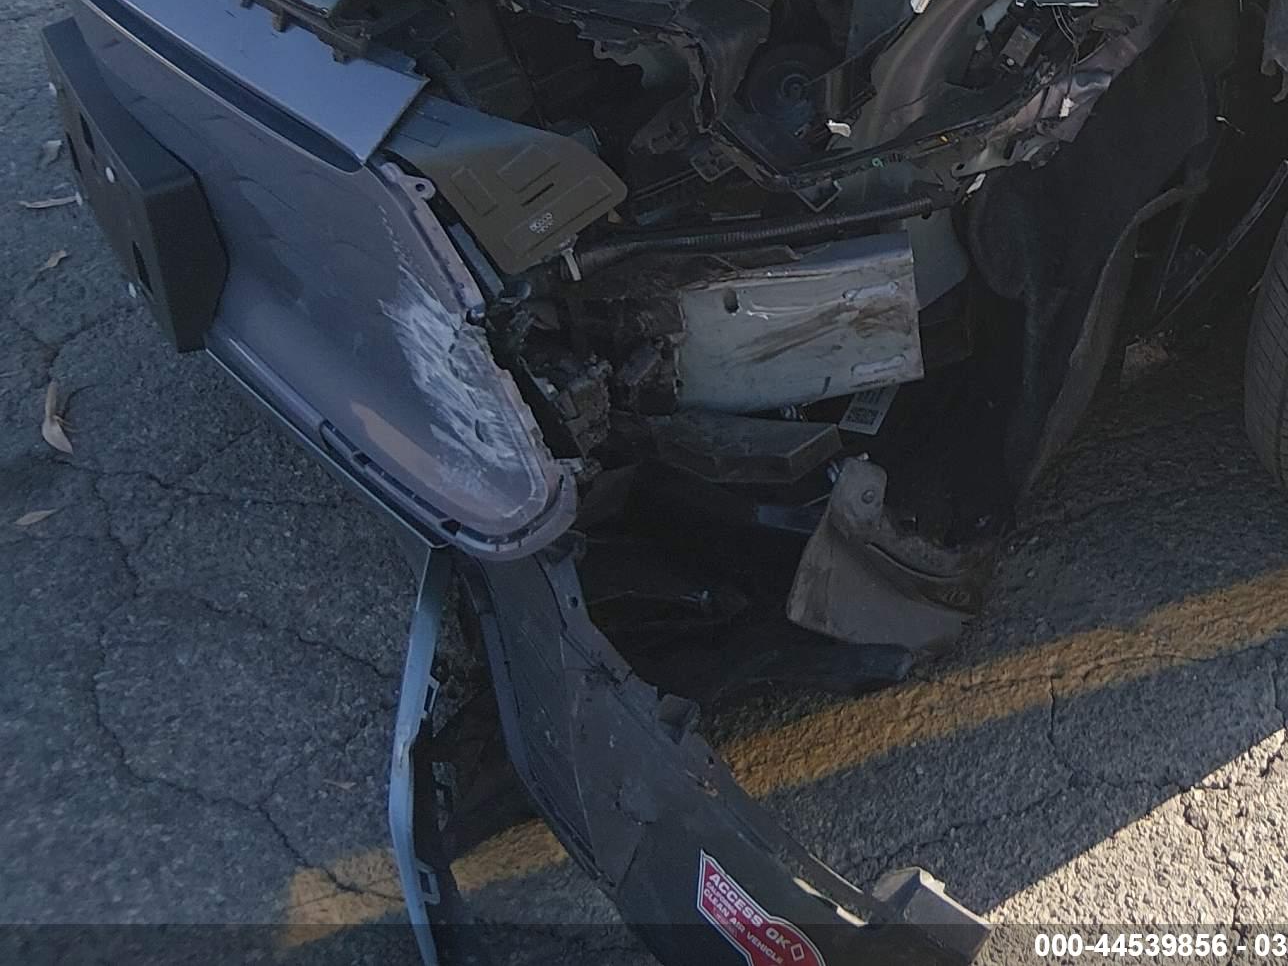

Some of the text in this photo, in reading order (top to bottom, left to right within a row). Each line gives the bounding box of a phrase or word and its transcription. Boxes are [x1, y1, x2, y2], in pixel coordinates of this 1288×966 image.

[704, 889, 730, 917] CLEAN
[729, 917, 745, 933] AIR
[746, 932, 784, 964] VEHICLE
[709, 874, 763, 927] ACCESS
[766, 928, 791, 949] OK
